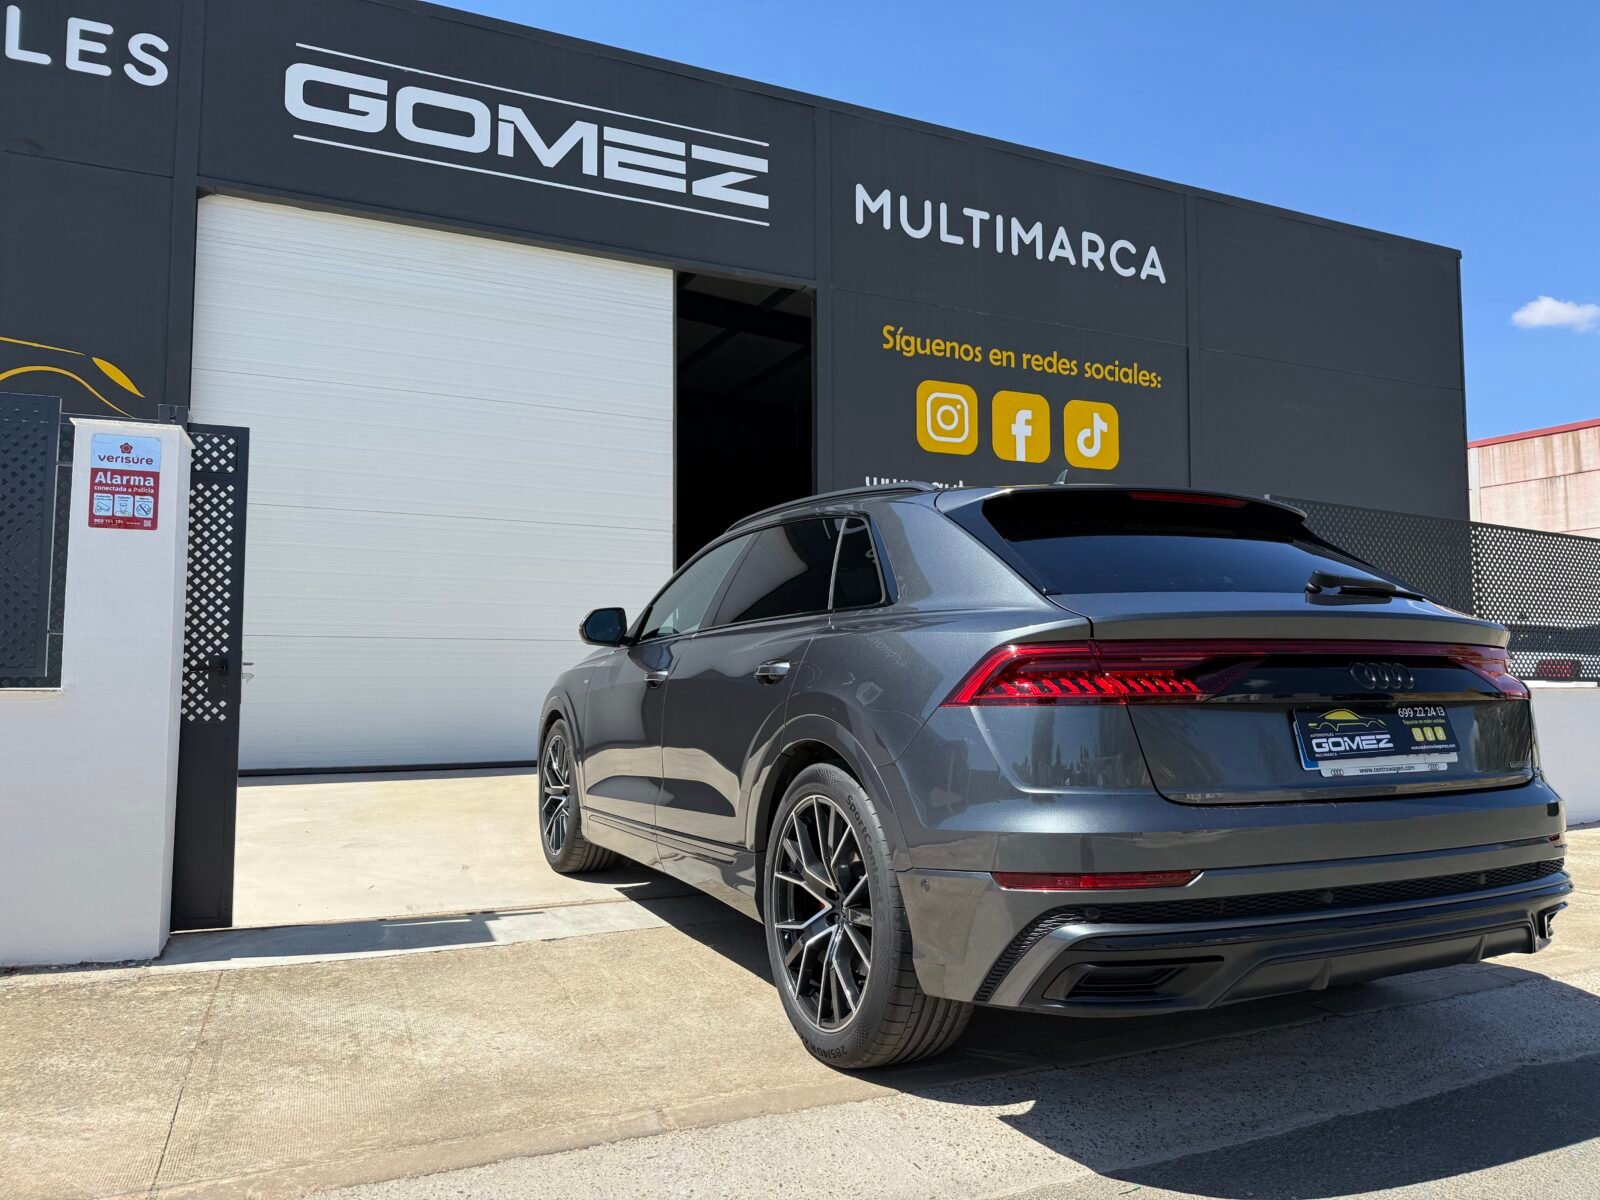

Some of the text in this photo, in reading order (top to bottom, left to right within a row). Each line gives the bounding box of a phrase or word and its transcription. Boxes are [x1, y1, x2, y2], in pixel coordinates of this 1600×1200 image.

[4, 4, 169, 87] LES
[284, 62, 770, 210] GOMEZ
[854, 183, 1168, 285] MULTIMARCA
[882, 324, 1163, 389] Síguenos en redes sociales:
[98, 454, 153, 465] verisure
[94, 471, 154, 487] Alarma
[1397, 706, 1446, 718] 699 22 24 13
[1311, 734, 1394, 753] GOMEZ
[1358, 764, 1416, 775] www.centrowagen.com
